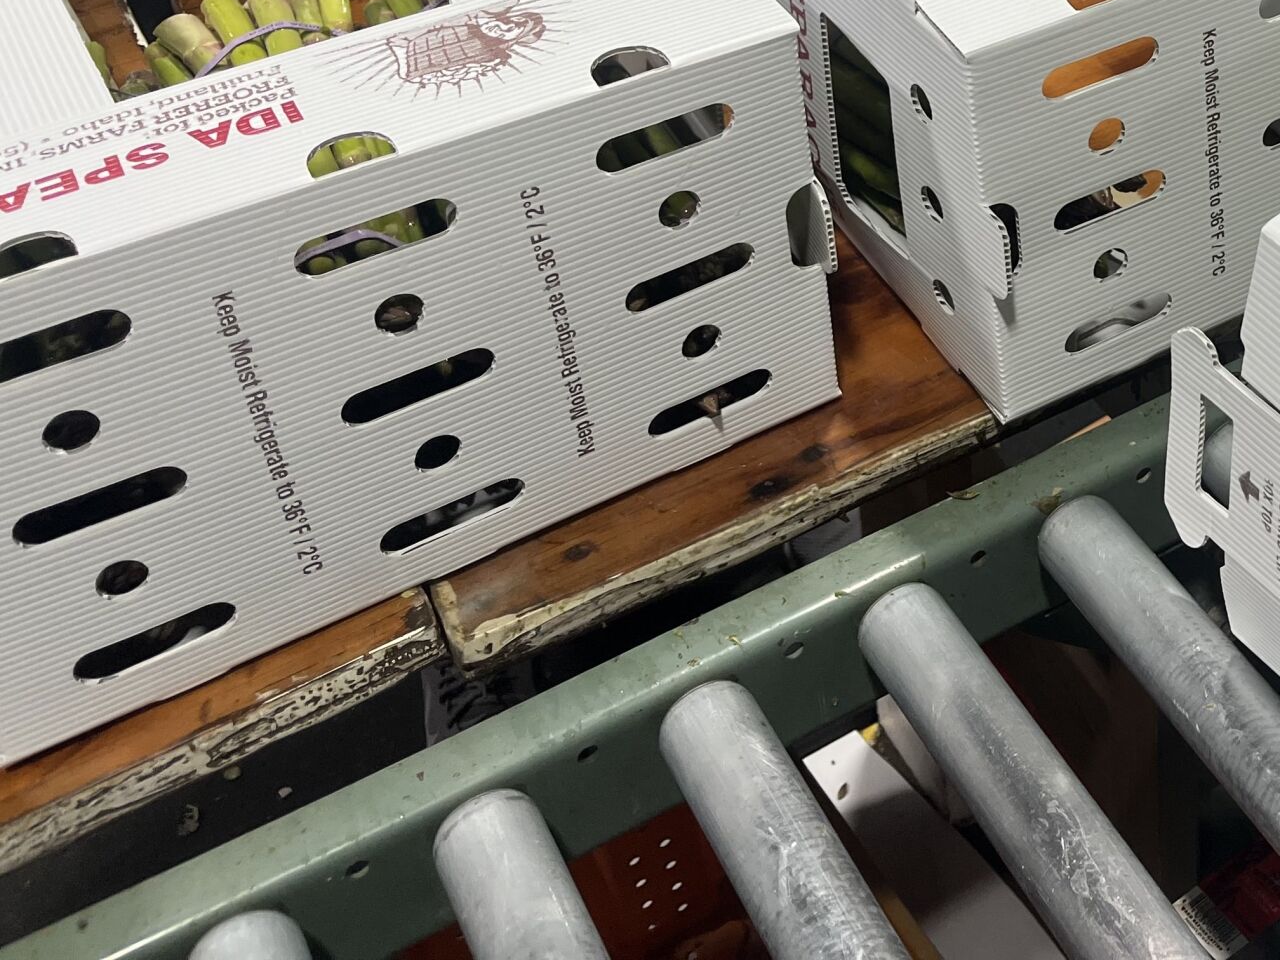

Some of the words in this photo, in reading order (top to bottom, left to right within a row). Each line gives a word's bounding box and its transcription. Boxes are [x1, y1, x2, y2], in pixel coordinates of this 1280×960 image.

[1201, 27, 1217, 67] Keep
[149, 64, 282, 110] Fruitland,
[154, 73, 295, 126] FROERER
[196, 87, 298, 127] Packed
[1203, 68, 1221, 112] Moist
[62, 107, 146, 137] Idaho
[187, 100, 304, 149] IDA
[1205, 111, 1223, 191] Refrigerate
[0, 142, 170, 213] SPEA
[519, 185, 545, 220] 2°C
[1209, 190, 1224, 208] to
[1209, 208, 1226, 241] 36°F
[530, 232, 557, 272] 36°F
[1211, 250, 1227, 277] 2°C
[543, 272, 561, 293] to
[212, 290, 241, 337] Keep
[547, 291, 581, 380] Refrigerate
[228, 339, 261, 390] Moist
[564, 376, 590, 422] Moist
[245, 389, 290, 481] Refrigerate
[577, 419, 597, 458] Keep
[275, 480, 297, 500] to
[282, 499, 312, 536] 36°F
[1260, 504, 1273, 534] TOP
[297, 545, 323, 576] 2°C
